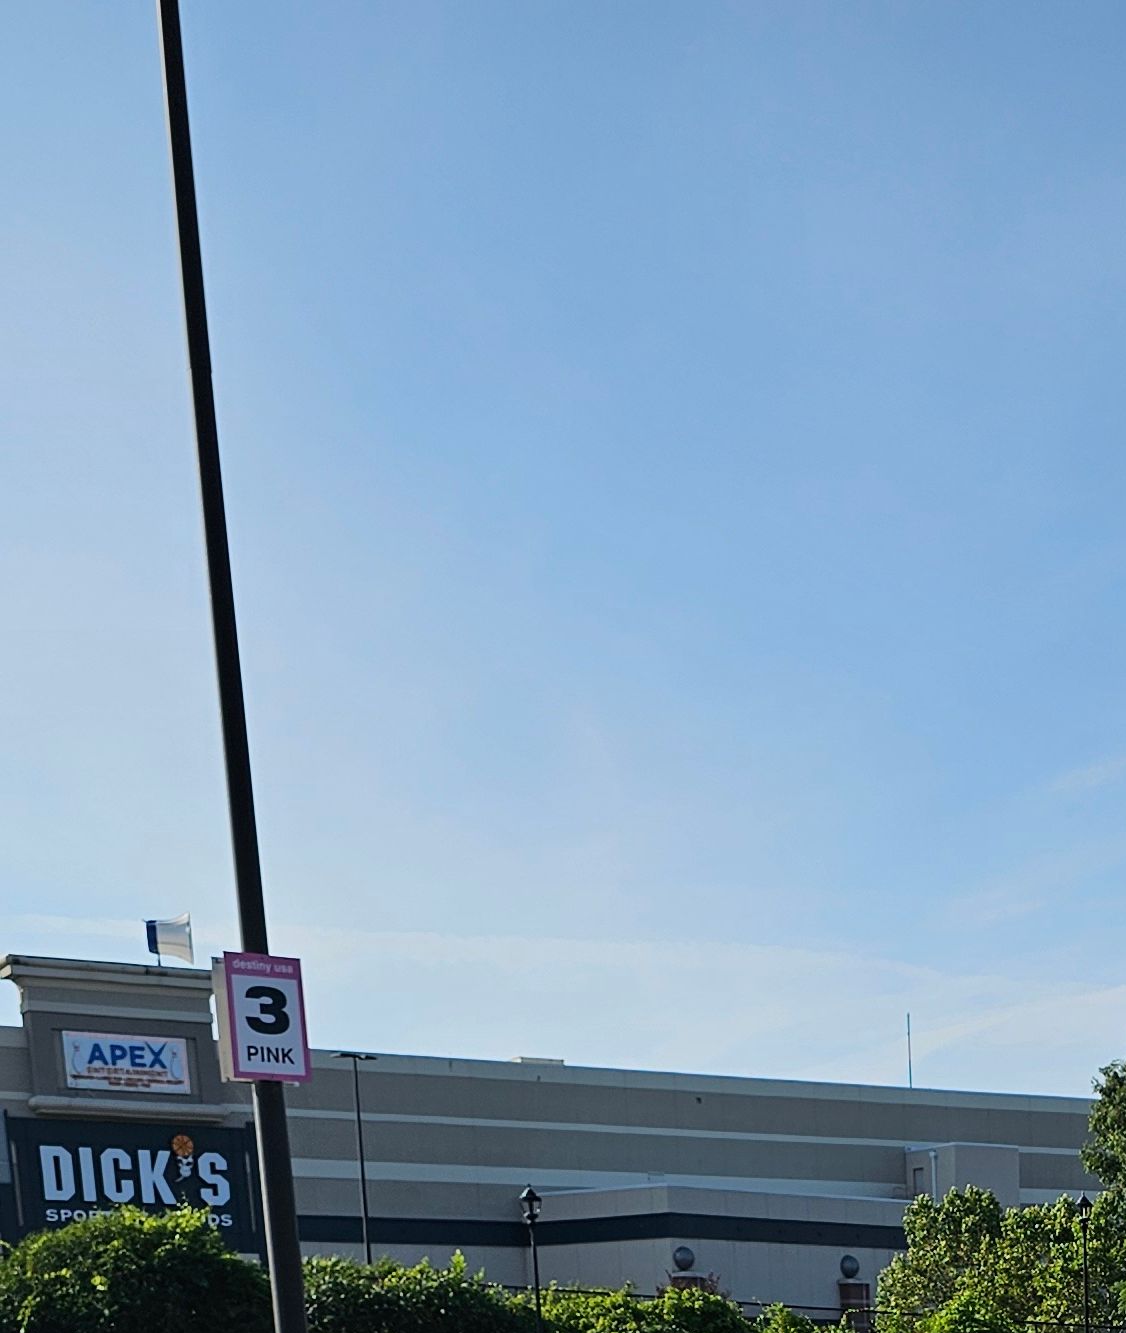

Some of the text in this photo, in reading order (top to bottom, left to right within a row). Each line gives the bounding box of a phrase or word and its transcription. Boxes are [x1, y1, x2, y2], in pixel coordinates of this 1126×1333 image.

[232, 959, 272, 974] destiny
[245, 985, 290, 1035] 3
[87, 1041, 168, 1069] APEX
[246, 1045, 295, 1065] PINK
[39, 1136, 231, 1206] DICK'S
